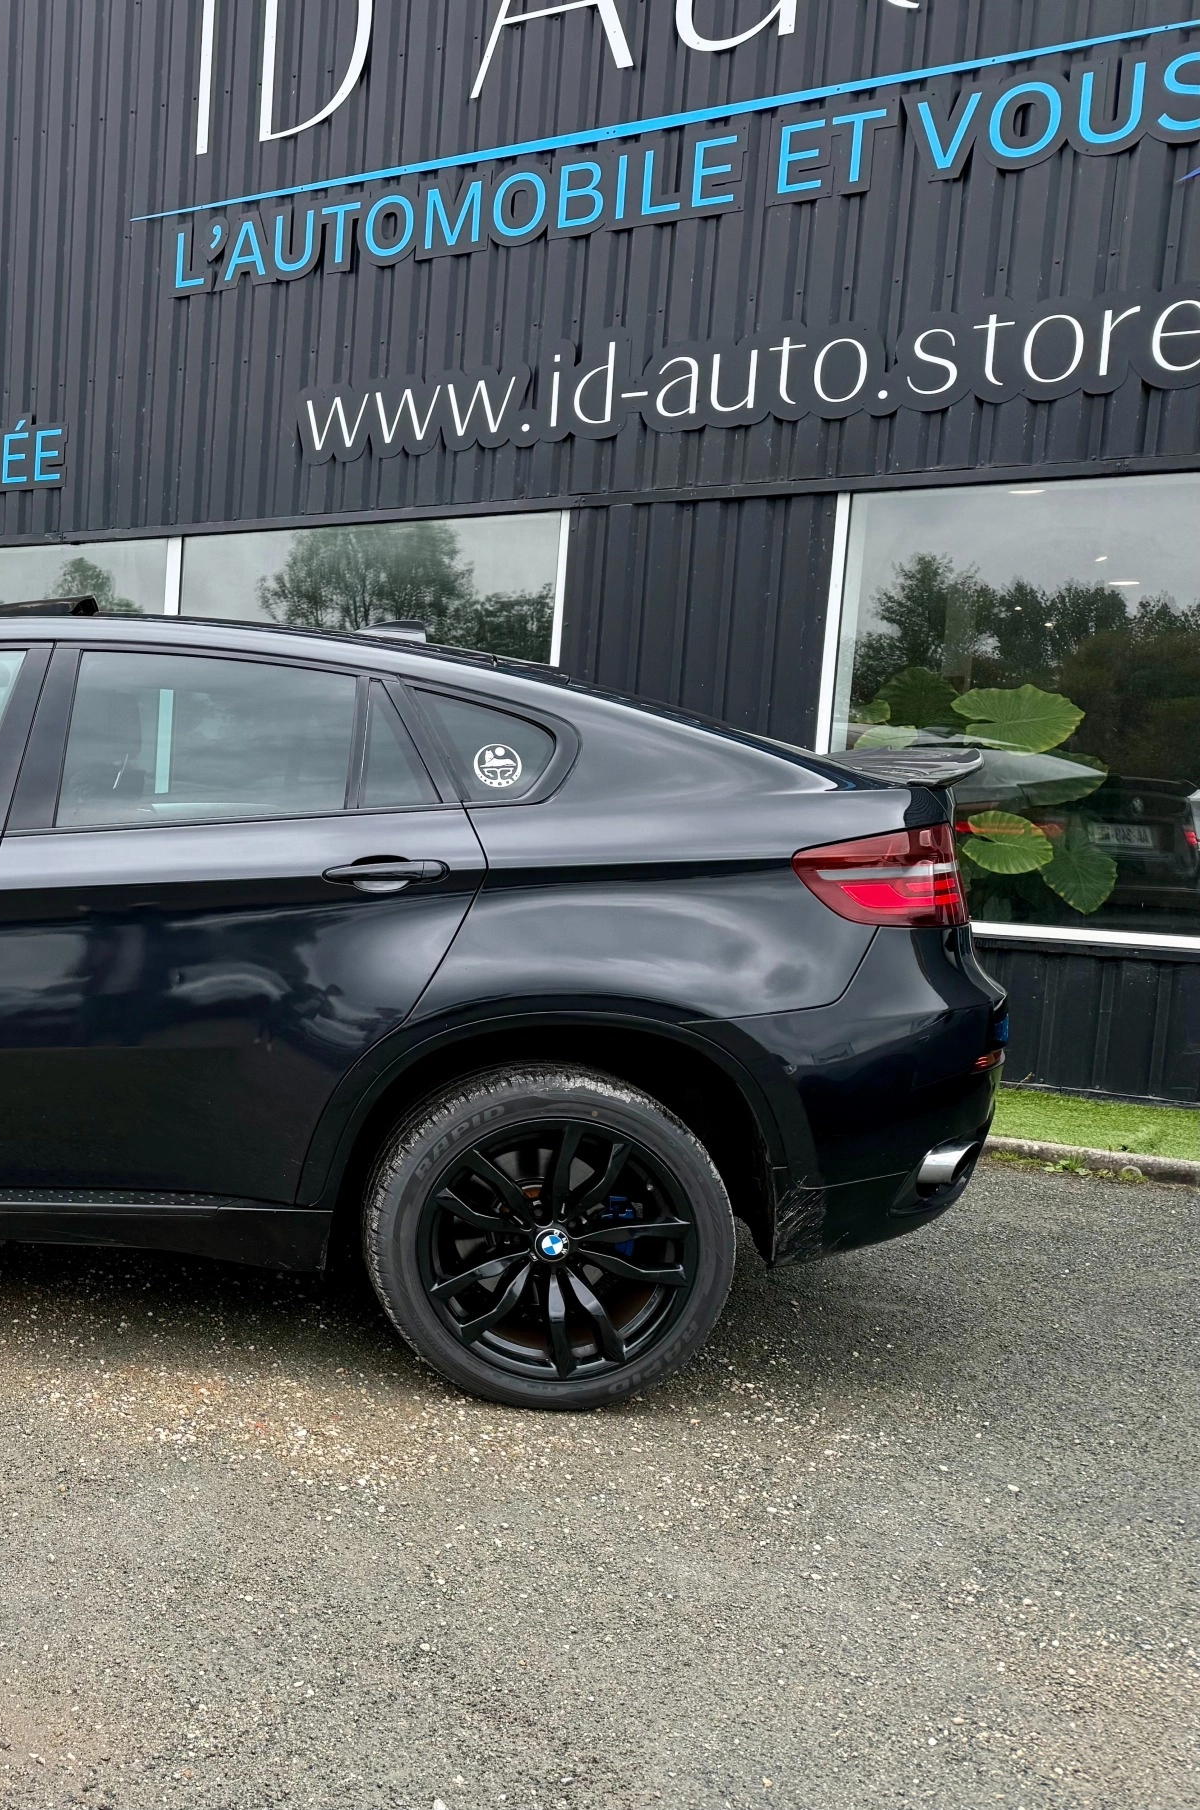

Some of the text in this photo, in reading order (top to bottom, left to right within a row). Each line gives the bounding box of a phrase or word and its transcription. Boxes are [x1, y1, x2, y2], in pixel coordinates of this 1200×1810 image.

[175, 51, 1200, 289] L'AUTOMOBILE ET VOUS
[306, 299, 1200, 451] www.id-auto.store
[415, 1105, 505, 1181] RAPID
